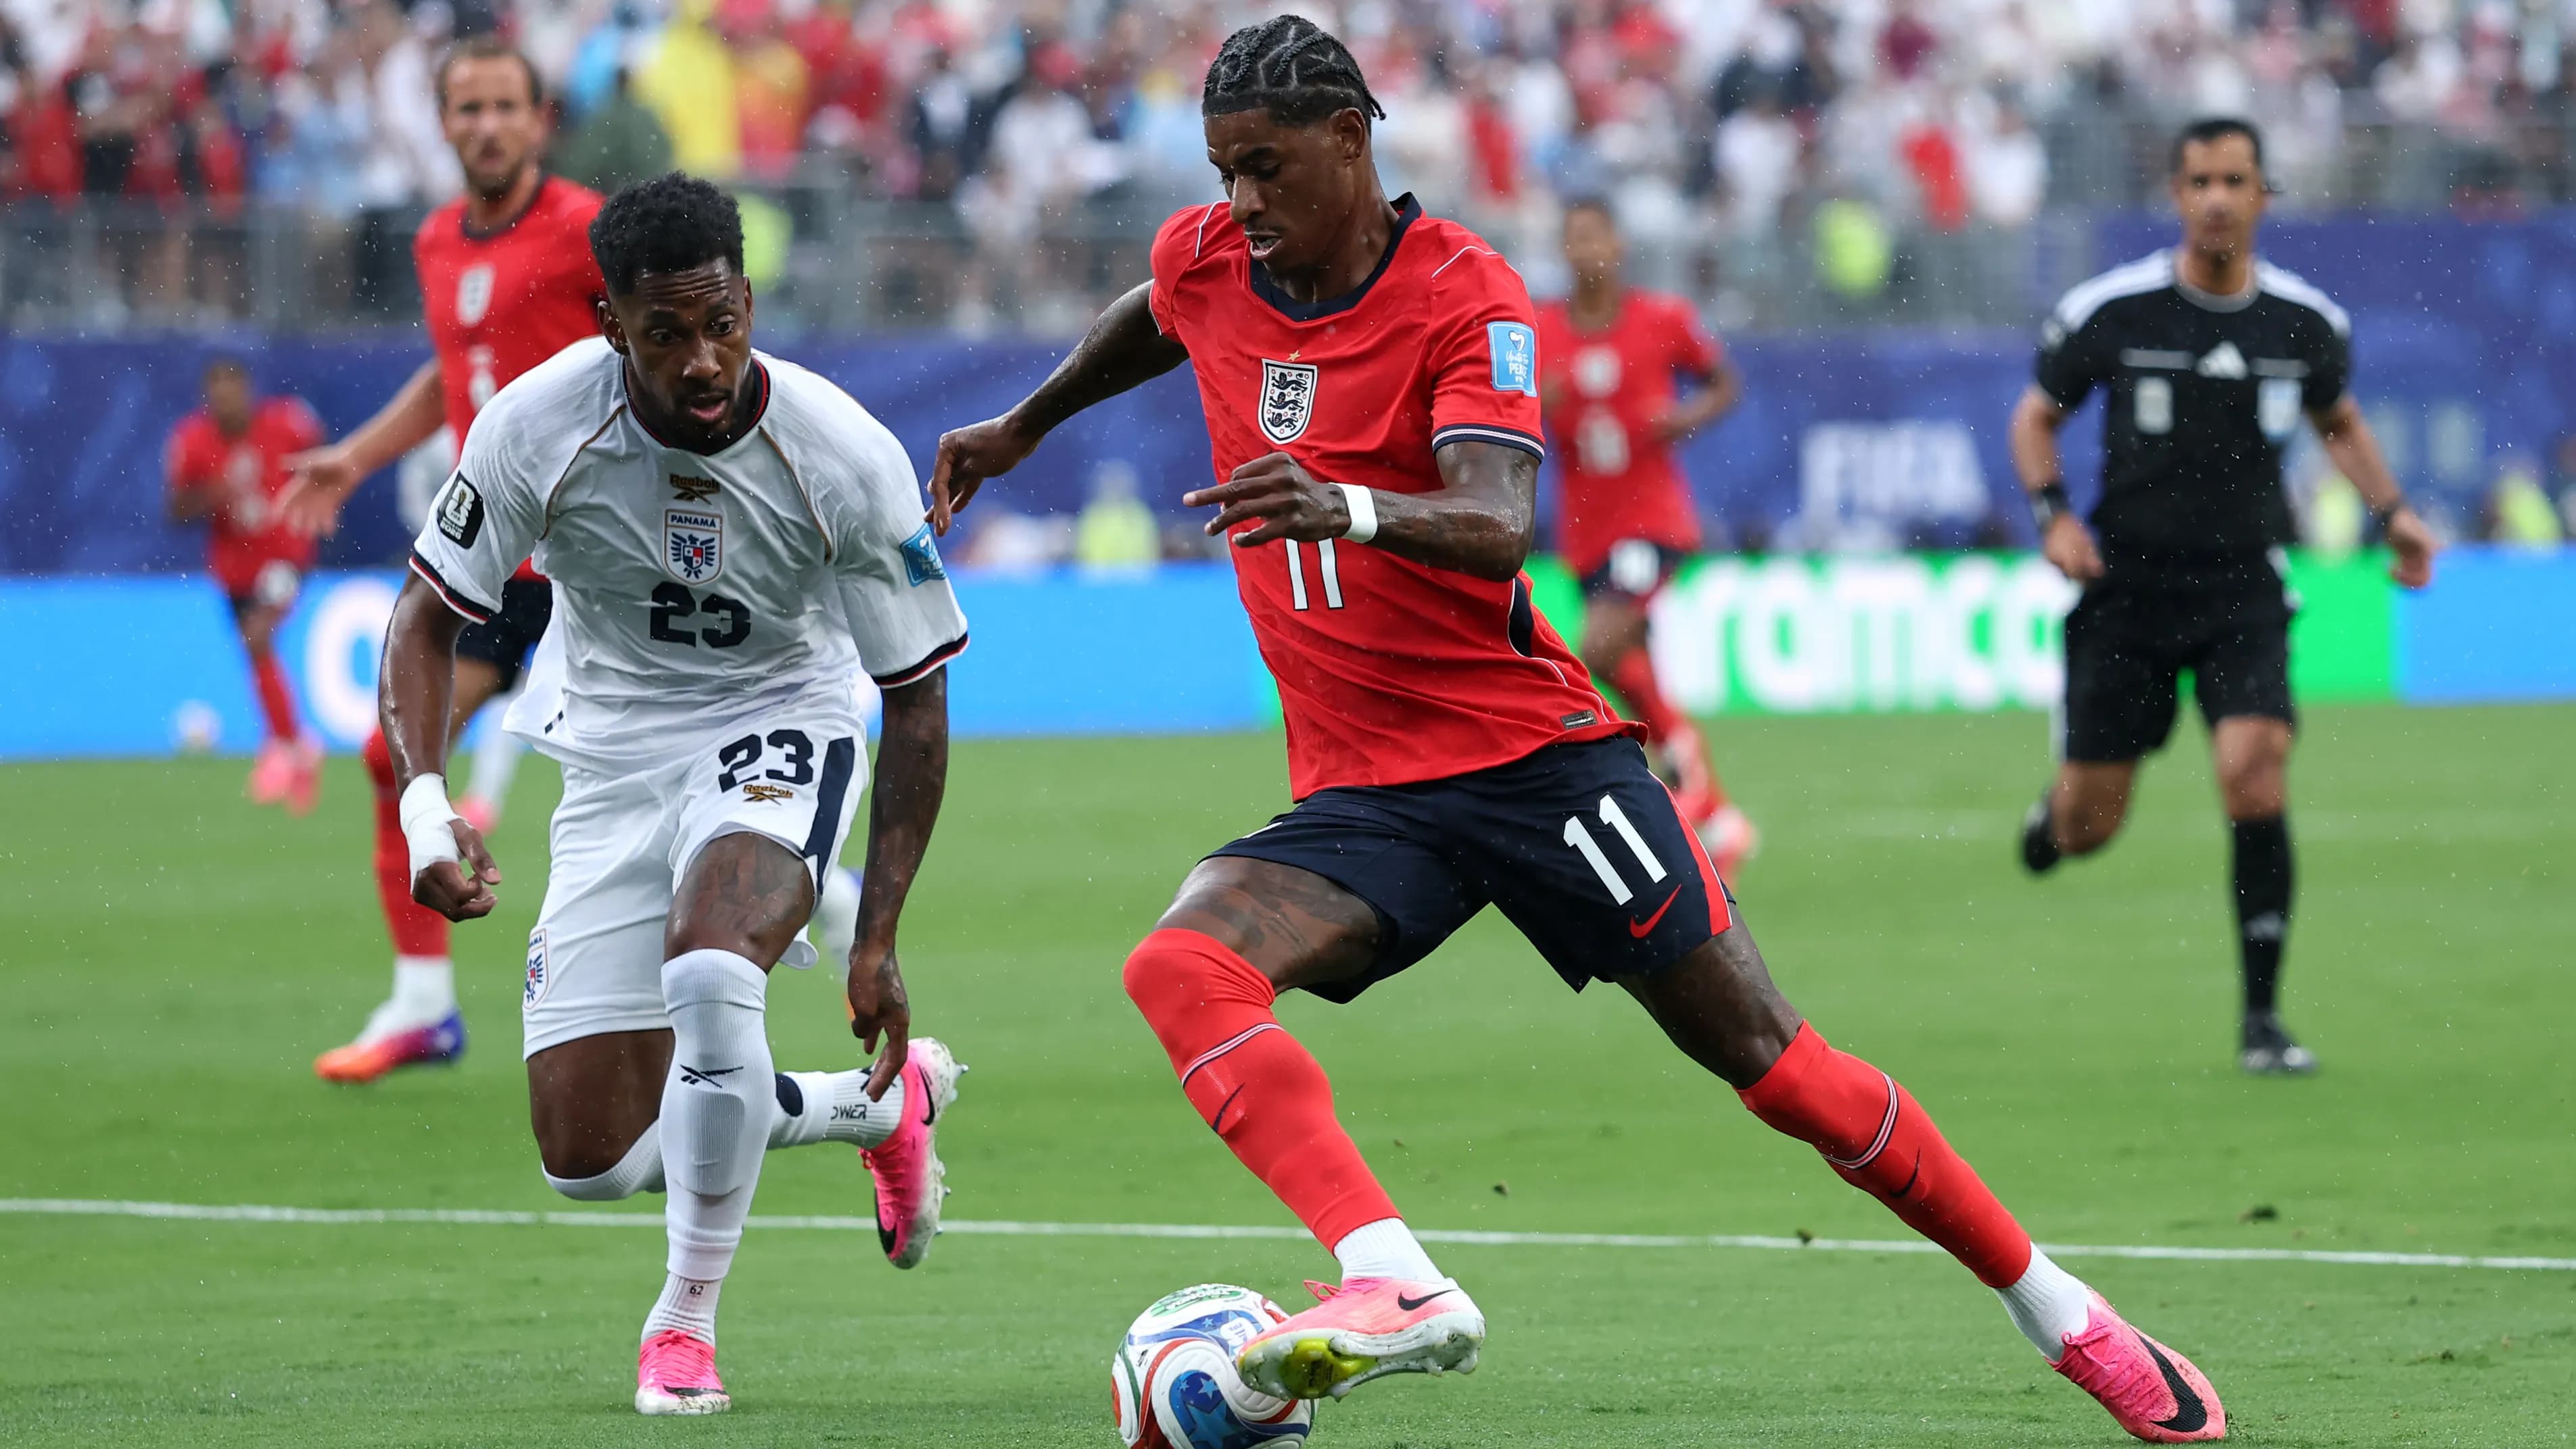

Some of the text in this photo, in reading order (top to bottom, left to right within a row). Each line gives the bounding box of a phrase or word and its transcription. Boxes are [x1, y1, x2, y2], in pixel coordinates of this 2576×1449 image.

[650, 581, 751, 648] 23
[1650, 554, 2068, 709] ramco
[719, 729, 813, 793] 23
[743, 784, 794, 799] Reebok
[1563, 793, 1668, 906] 11
[830, 1103, 867, 1120] OWER
